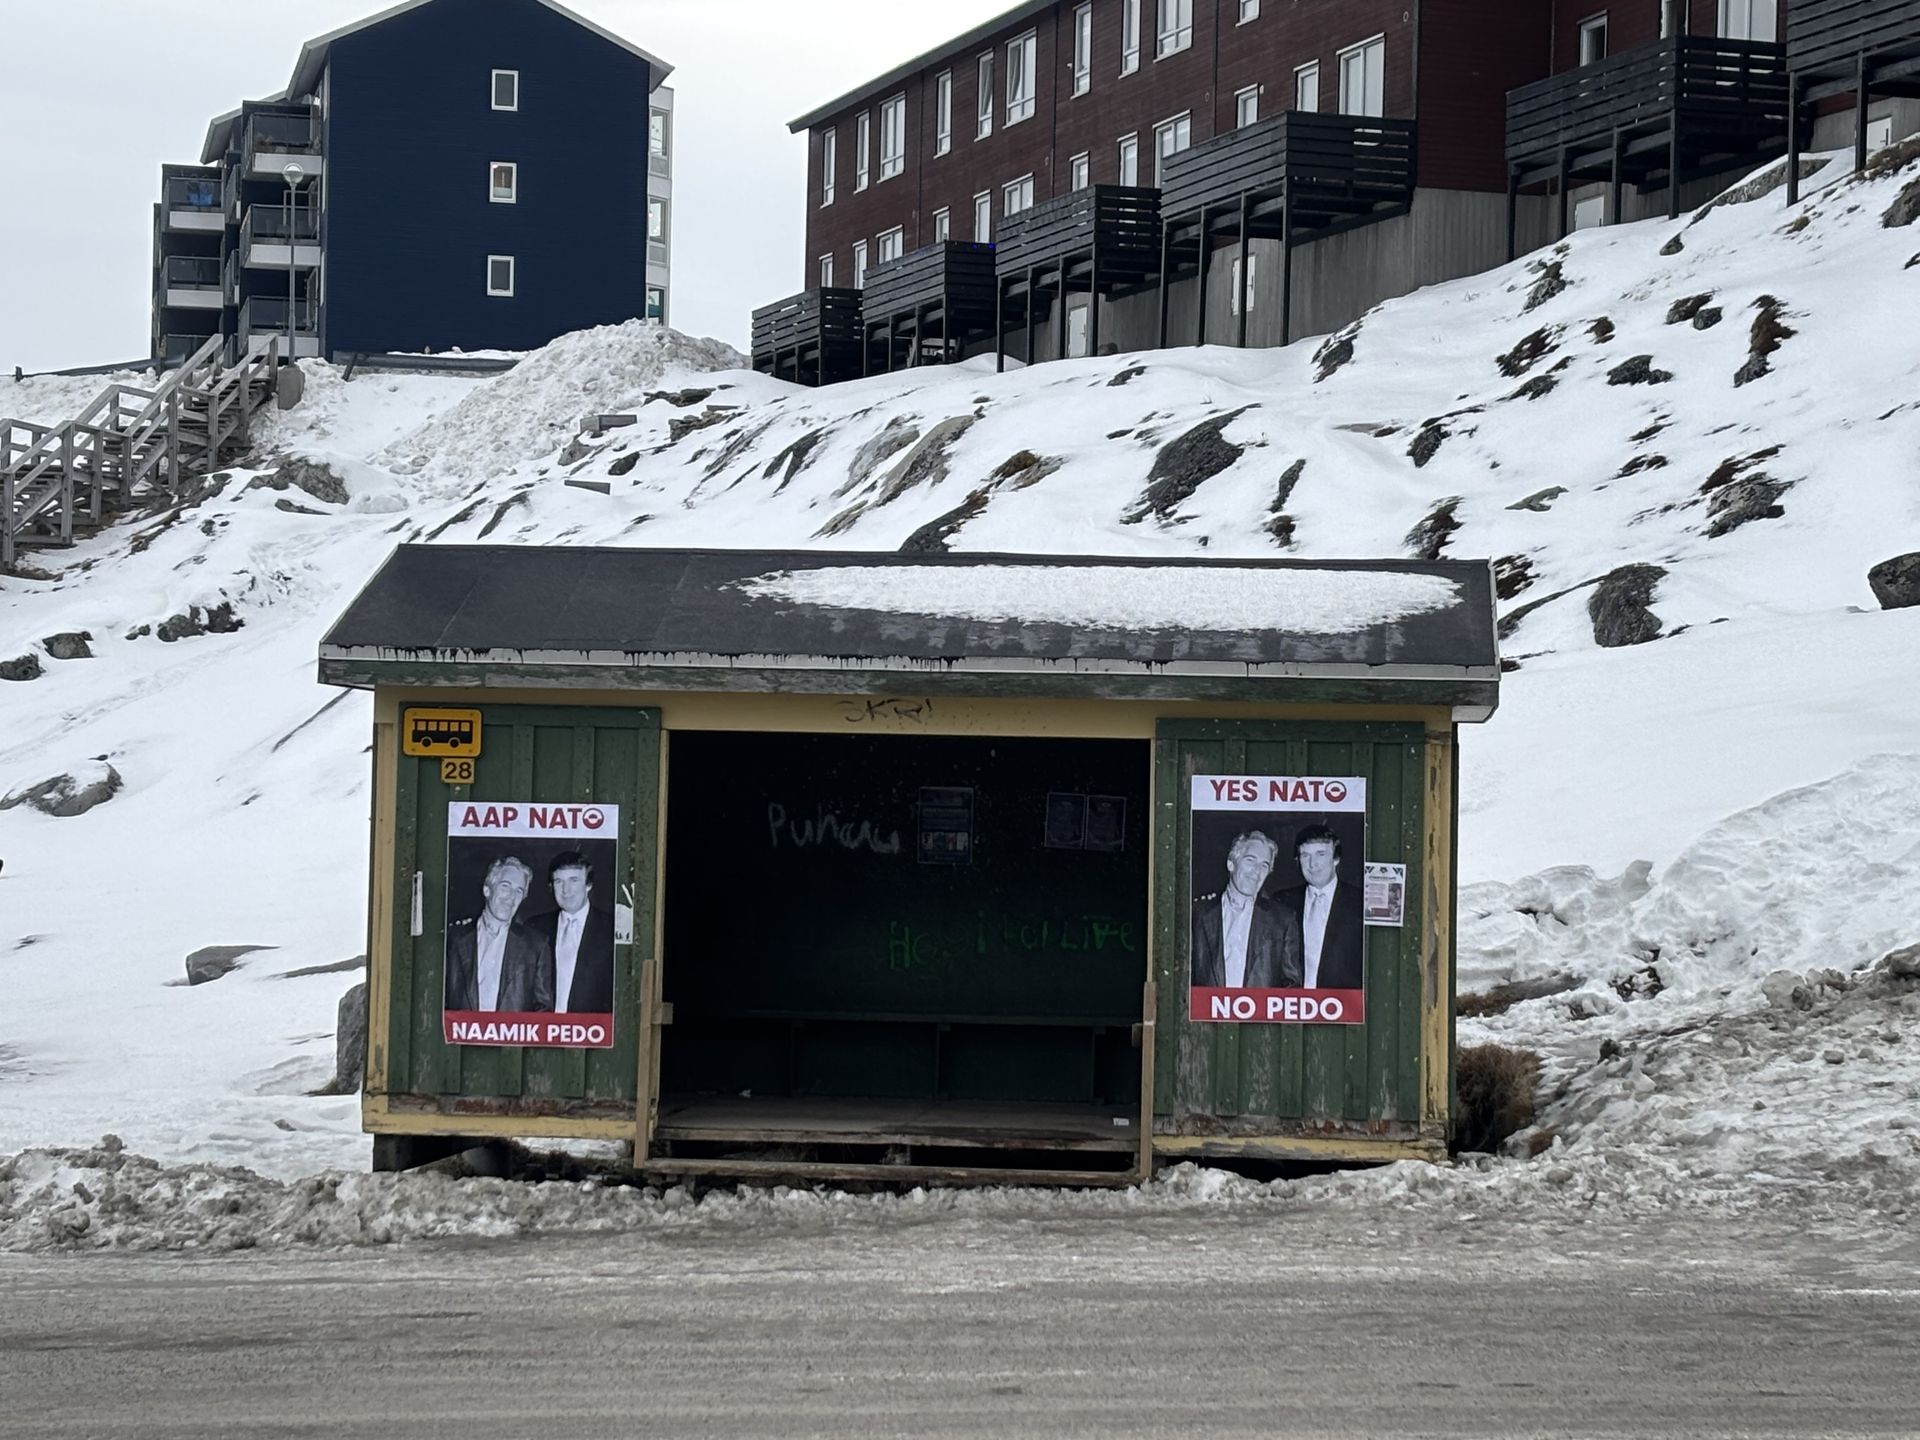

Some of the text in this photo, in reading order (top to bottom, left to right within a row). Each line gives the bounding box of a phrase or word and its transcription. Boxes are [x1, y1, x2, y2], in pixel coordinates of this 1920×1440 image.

[444, 761, 473, 780] 28
[1209, 779, 1348, 803] YES NATO
[461, 805, 605, 830] AAP NATO
[1211, 995, 1344, 1021] NO PEDO
[451, 1022, 605, 1044] NAAMIK PEDO
